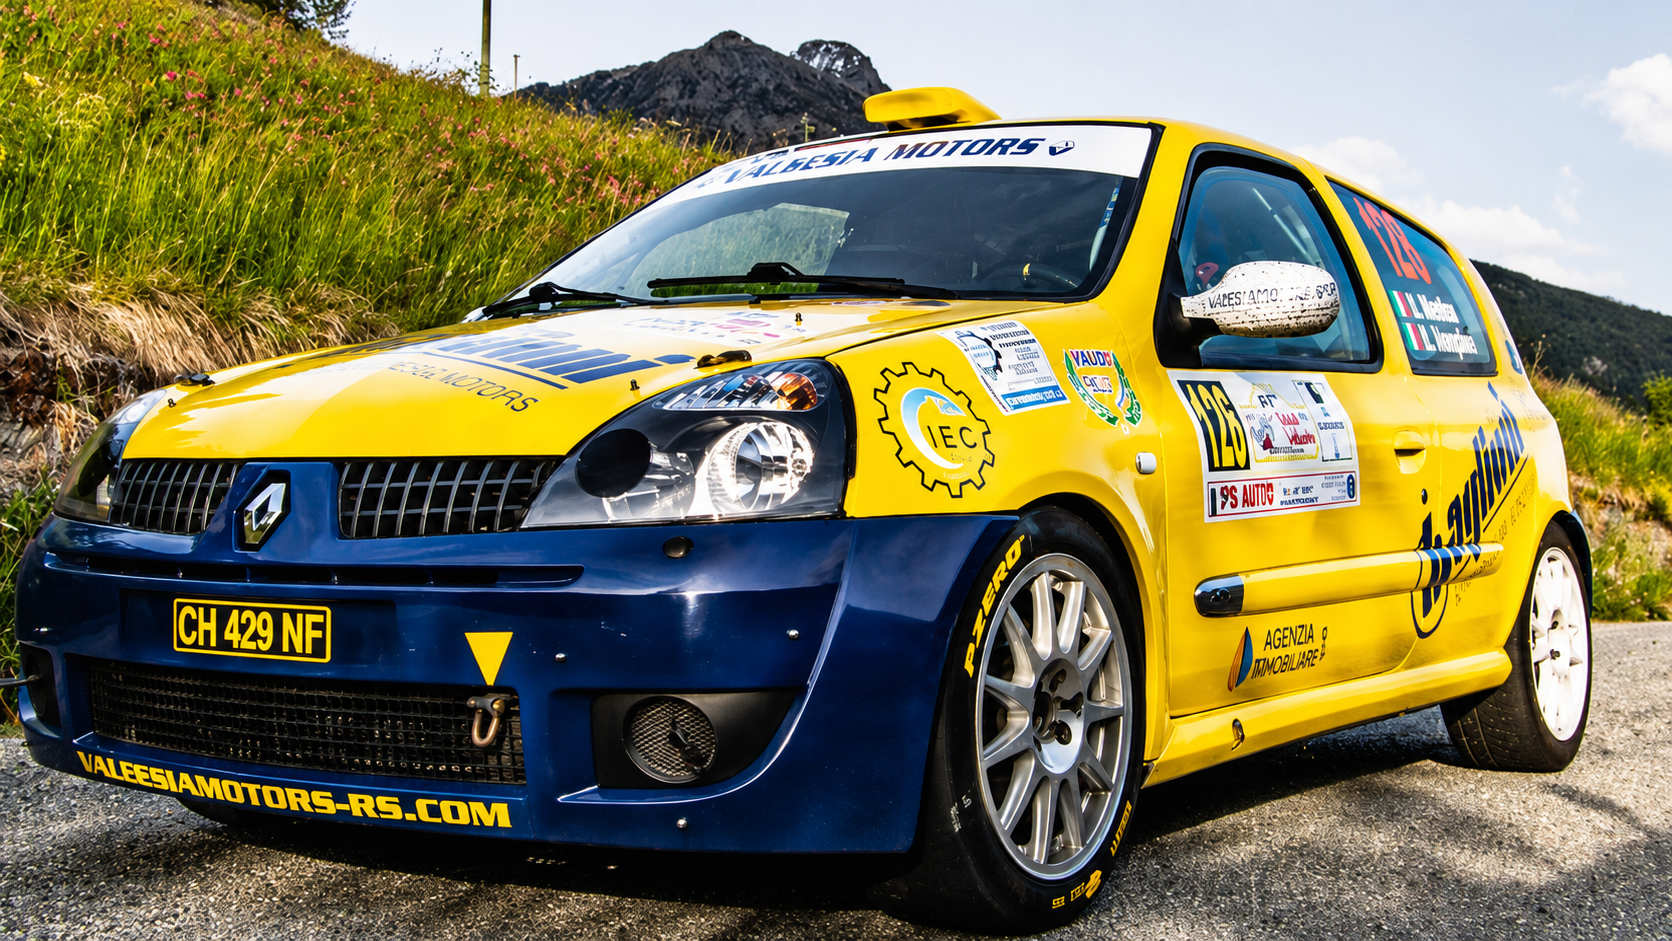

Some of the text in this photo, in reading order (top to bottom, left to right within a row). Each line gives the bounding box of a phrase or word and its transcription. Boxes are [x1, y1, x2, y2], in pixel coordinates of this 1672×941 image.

[883, 137, 1047, 161] MOTORS
[1352, 196, 1432, 285] 126
[926, 424, 978, 449] IEC
[1186, 383, 1248, 469] 126
[177, 604, 325, 655] CH 429 NF
[1263, 622, 1315, 652] AGENZIA
